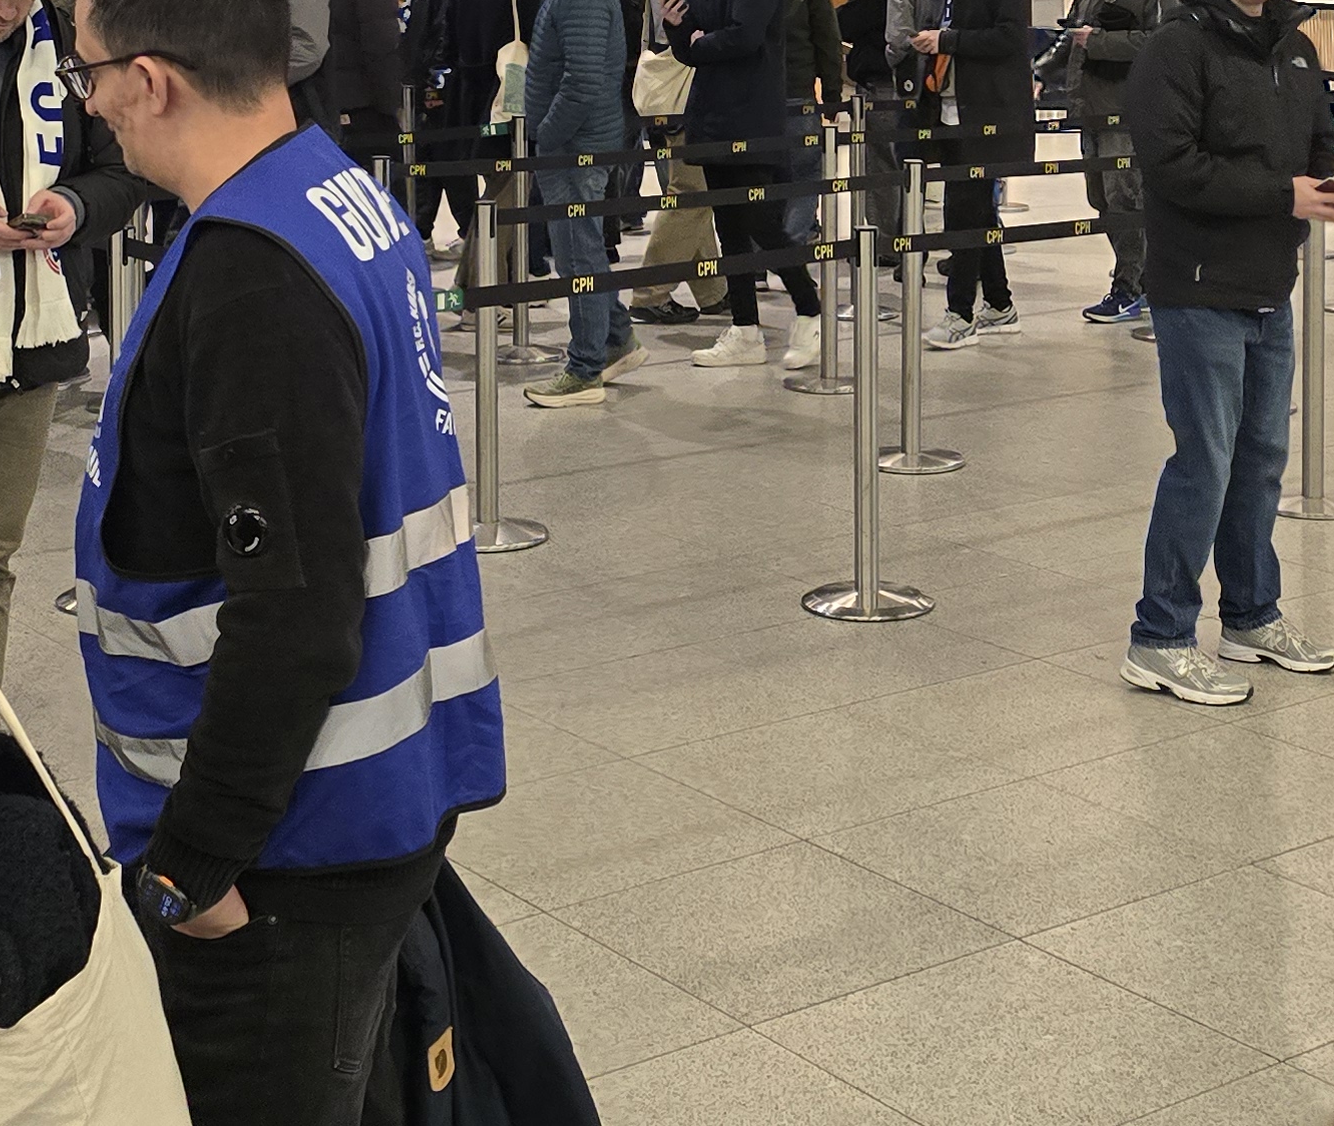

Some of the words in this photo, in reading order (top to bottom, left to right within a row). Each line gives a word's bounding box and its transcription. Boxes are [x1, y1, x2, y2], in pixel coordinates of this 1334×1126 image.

[919, 129, 931, 139] CPH
[984, 125, 996, 135] CPH
[398, 133, 414, 143] CPH
[805, 135, 818, 146] CPH
[851, 133, 864, 143] CPH
[732, 141, 746, 152] CPH
[657, 148, 672, 159] CPH
[495, 160, 511, 171] CPH
[578, 154, 593, 166] CPH
[1117, 157, 1130, 168] CPH
[410, 165, 427, 176] CPH
[970, 167, 984, 178] CPH
[1044, 162, 1058, 173] CPH
[833, 178, 847, 190] CPH
[748, 188, 765, 201] CPH
[661, 195, 677, 207] CPH
[567, 204, 585, 217] CPH
[1075, 221, 1090, 232] CPH
[987, 230, 1002, 243] CPH
[894, 237, 910, 250] CPH
[815, 245, 833, 258] CPH
[697, 261, 717, 276] CPH
[572, 277, 593, 292] CPH
